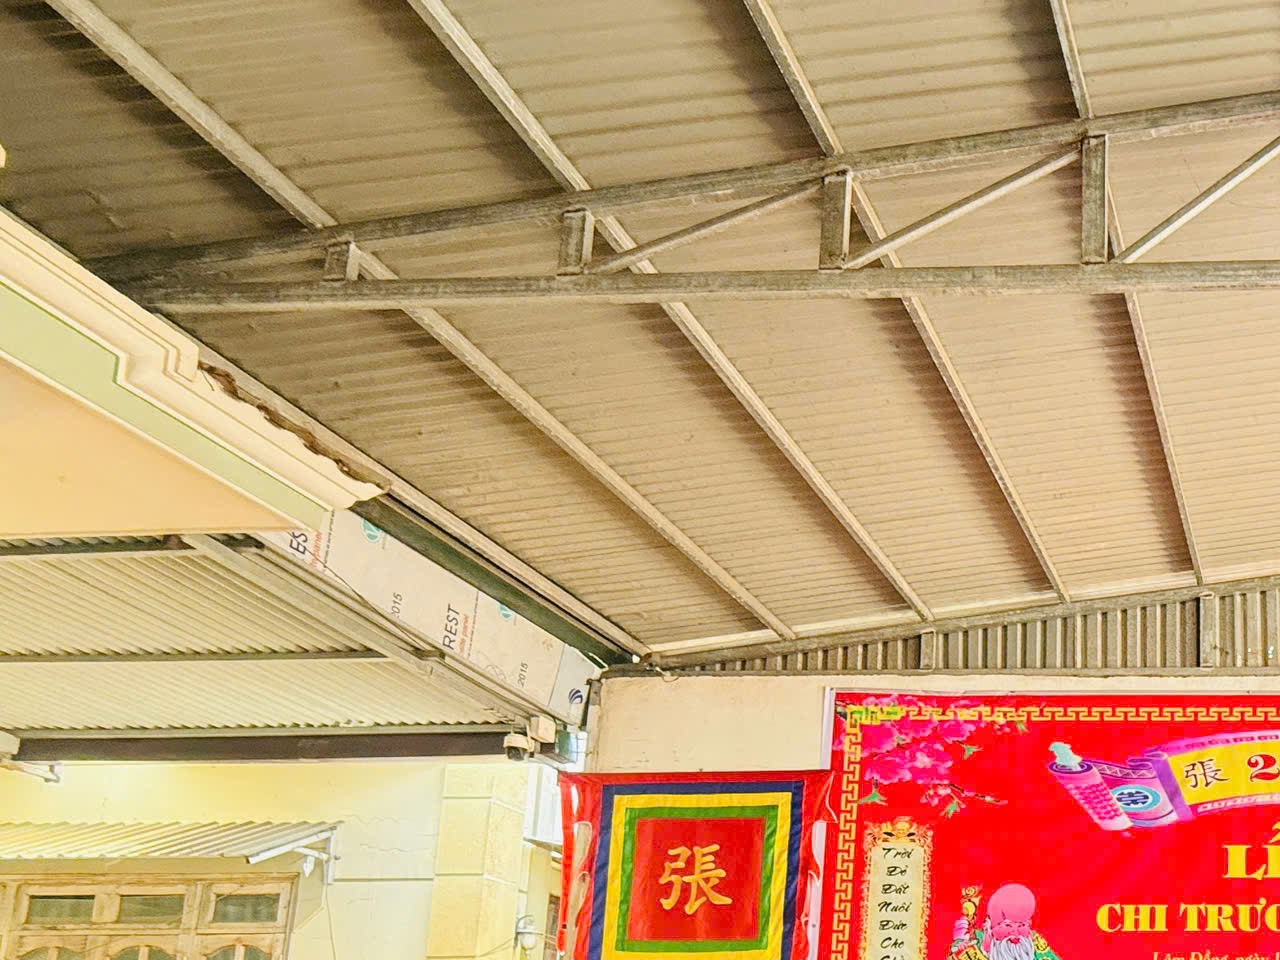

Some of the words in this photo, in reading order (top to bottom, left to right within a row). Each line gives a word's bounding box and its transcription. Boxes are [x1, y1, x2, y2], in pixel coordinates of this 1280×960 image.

[442, 603, 460, 650] REST
[517, 662, 529, 688] 2015
[1184, 760, 1229, 789] 張
[882, 847, 914, 859] Trời
[658, 843, 733, 916] 張
[1096, 903, 1169, 932] CHI
